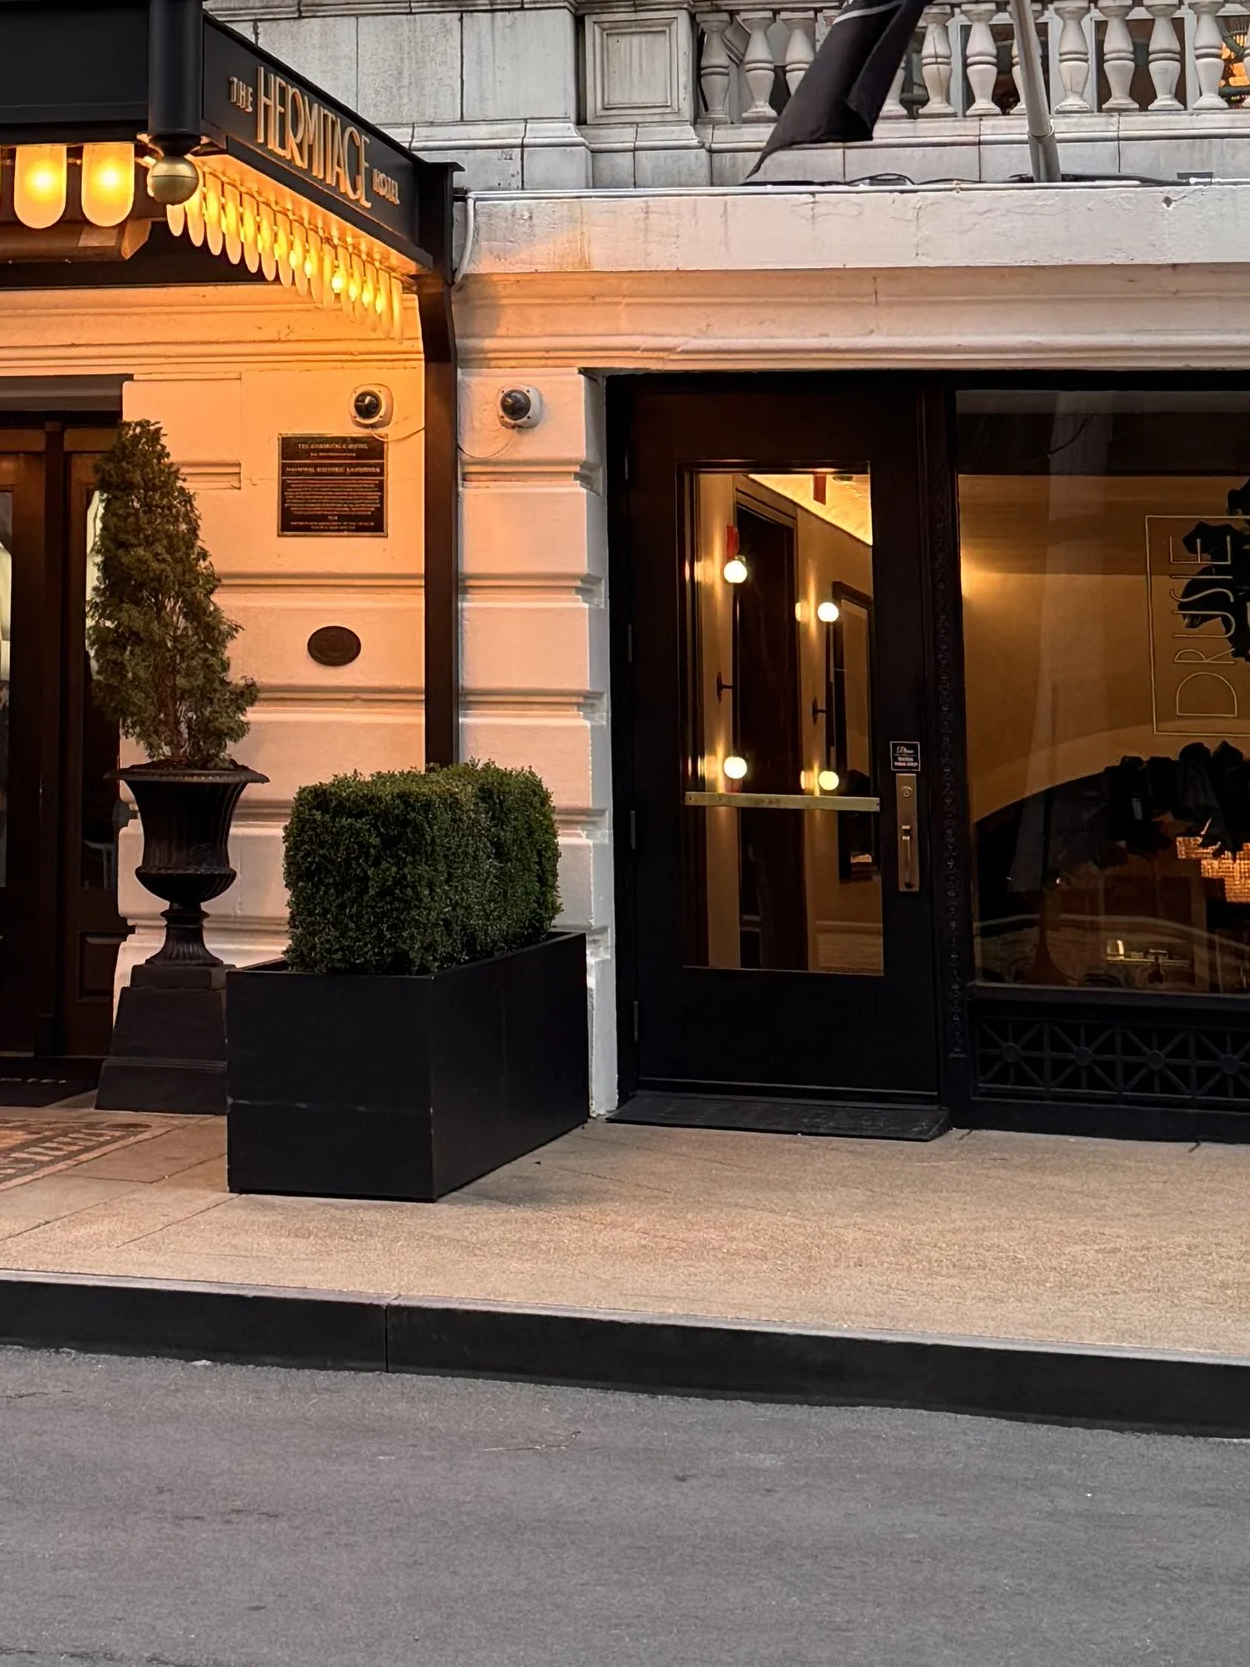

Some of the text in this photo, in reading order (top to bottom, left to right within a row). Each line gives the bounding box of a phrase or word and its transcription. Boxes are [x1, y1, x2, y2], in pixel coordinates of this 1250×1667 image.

[229, 65, 400, 209] THE HERMITAGE HOTEL
[1168, 534, 1238, 717] DRUSIE
